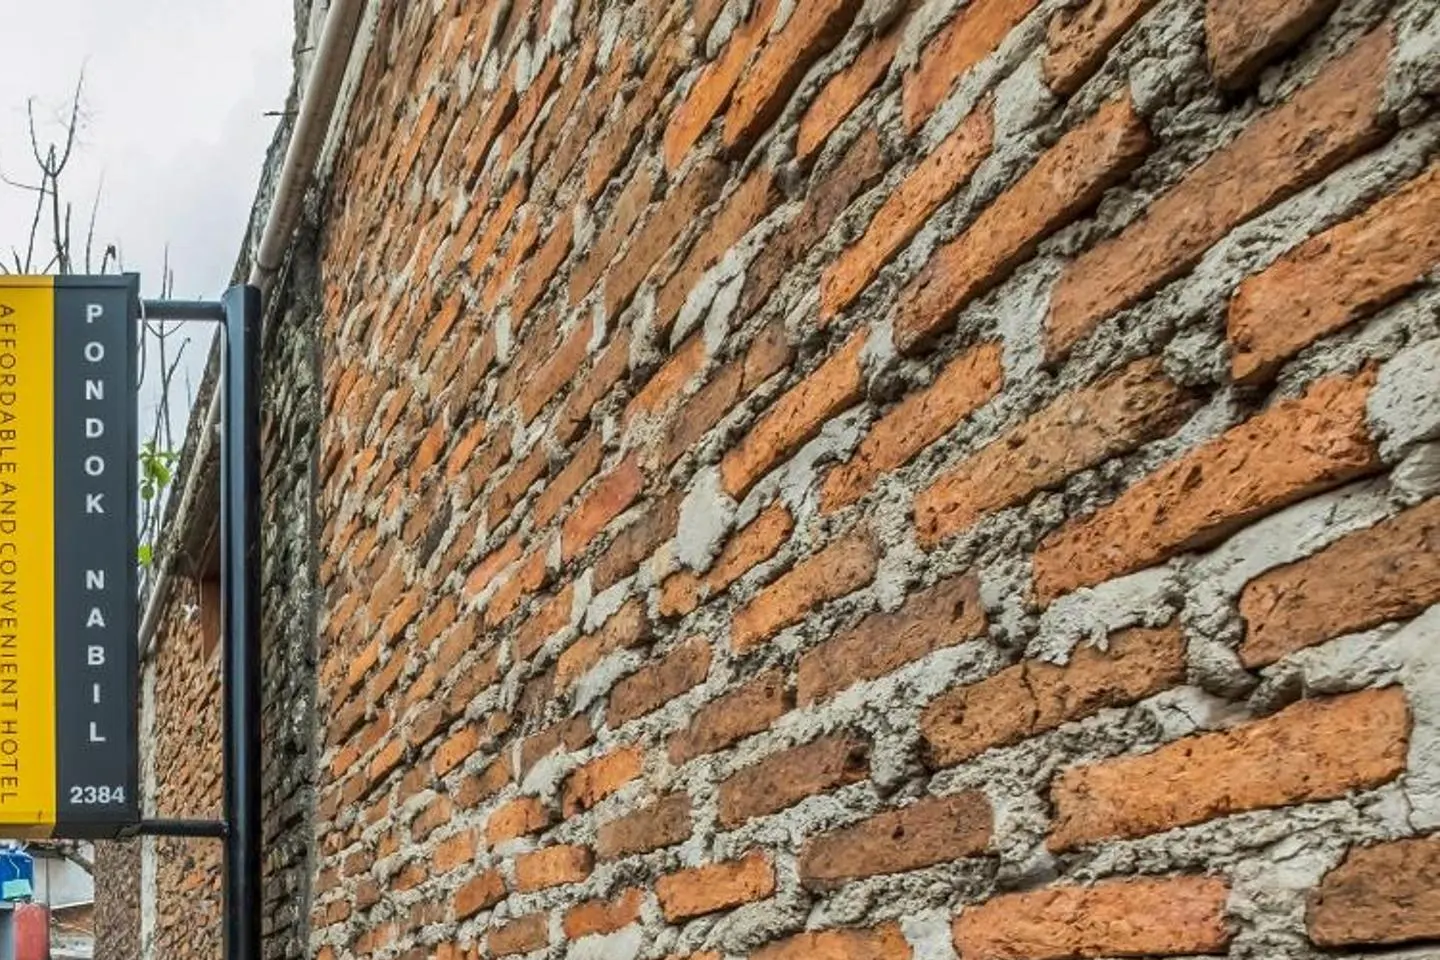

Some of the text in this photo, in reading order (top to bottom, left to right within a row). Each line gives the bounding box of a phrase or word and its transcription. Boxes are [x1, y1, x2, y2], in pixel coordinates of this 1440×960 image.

[0, 481, 17, 535] AND
[84, 304, 106, 742] PONDOK NABIL
[0, 542, 18, 711] CONVENIENT
[0, 719, 18, 804] HOTEL
[69, 786, 126, 804] 2384
